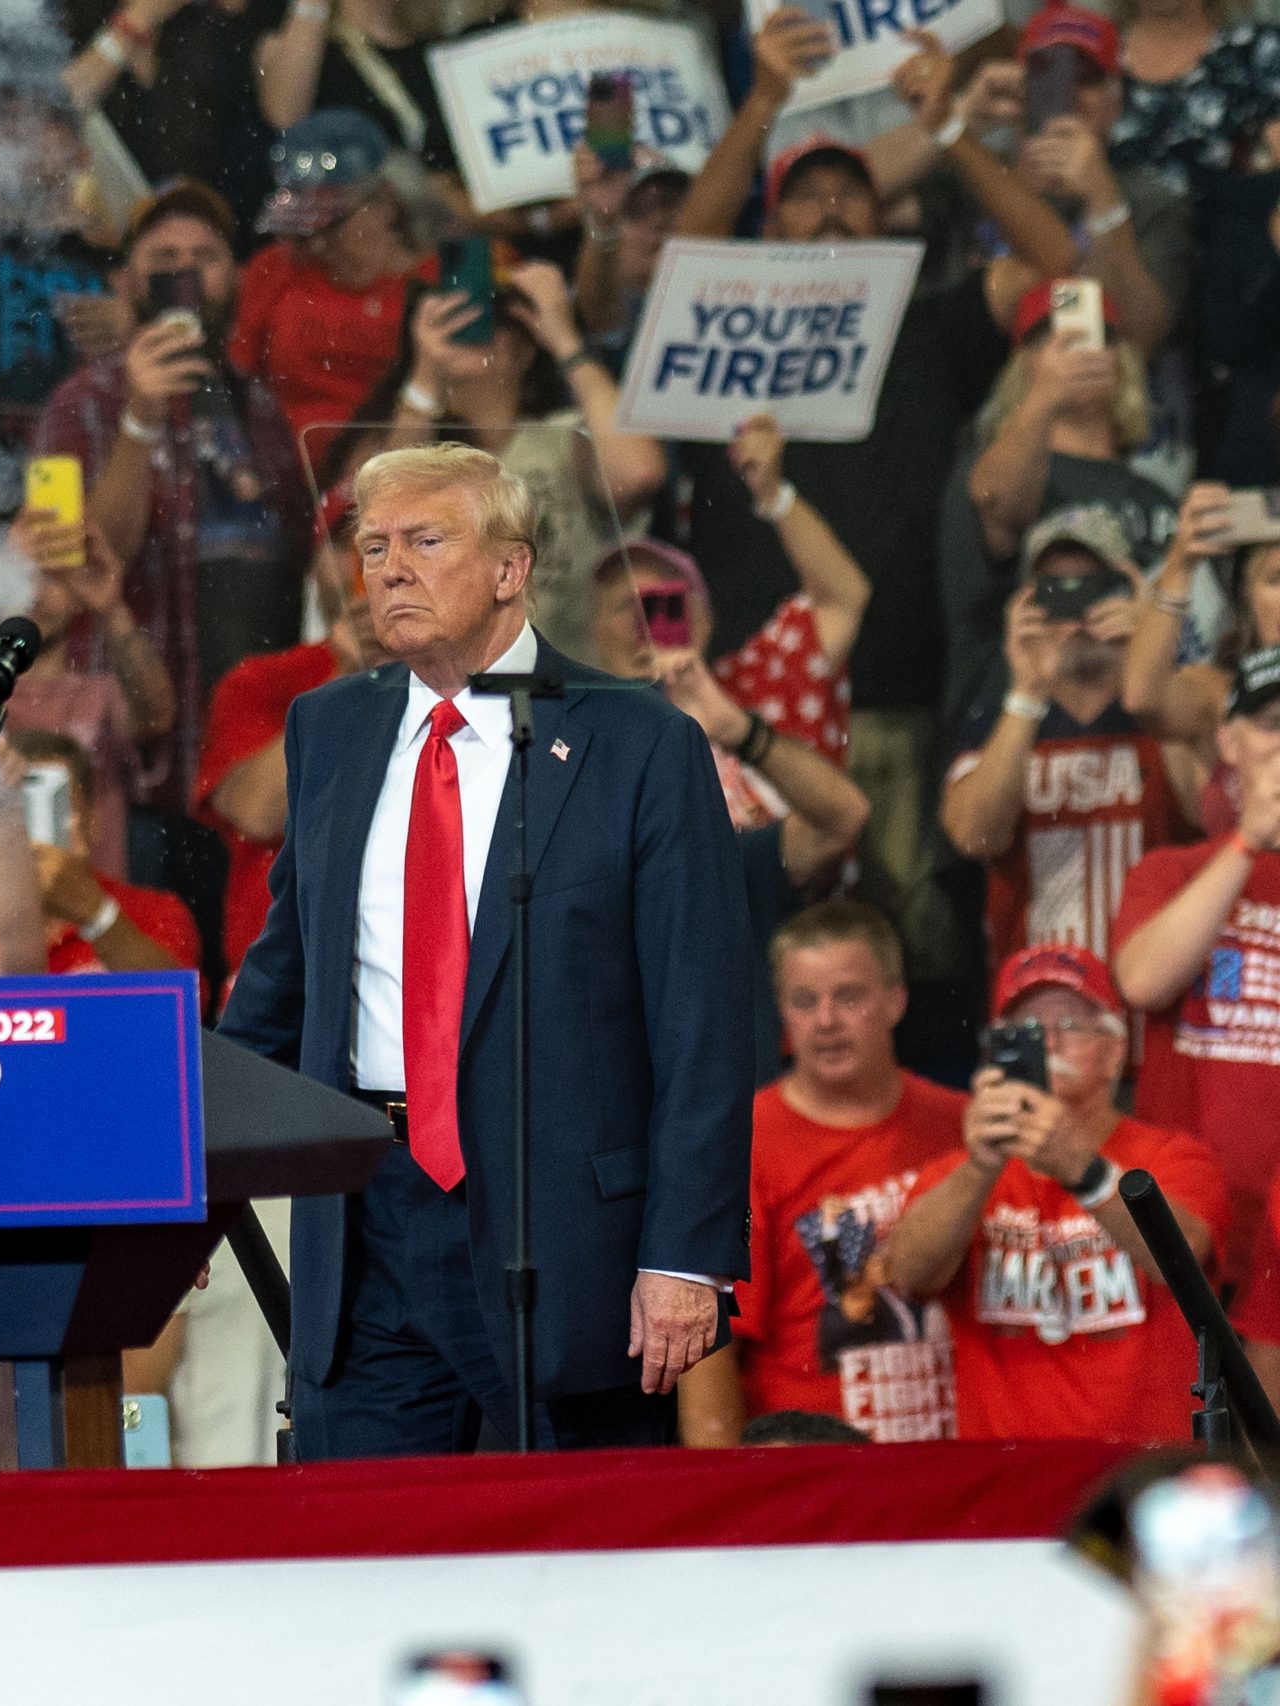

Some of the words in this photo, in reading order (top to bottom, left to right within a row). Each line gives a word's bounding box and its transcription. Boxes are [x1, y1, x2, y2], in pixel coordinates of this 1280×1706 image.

[493, 66, 685, 117] YOURE
[487, 103, 716, 166] FIRD!
[693, 301, 867, 343] YOU'RE
[653, 344, 867, 398] FIRED!
[1026, 744, 1143, 814] USA
[981, 1248, 1143, 1322] HAREM
